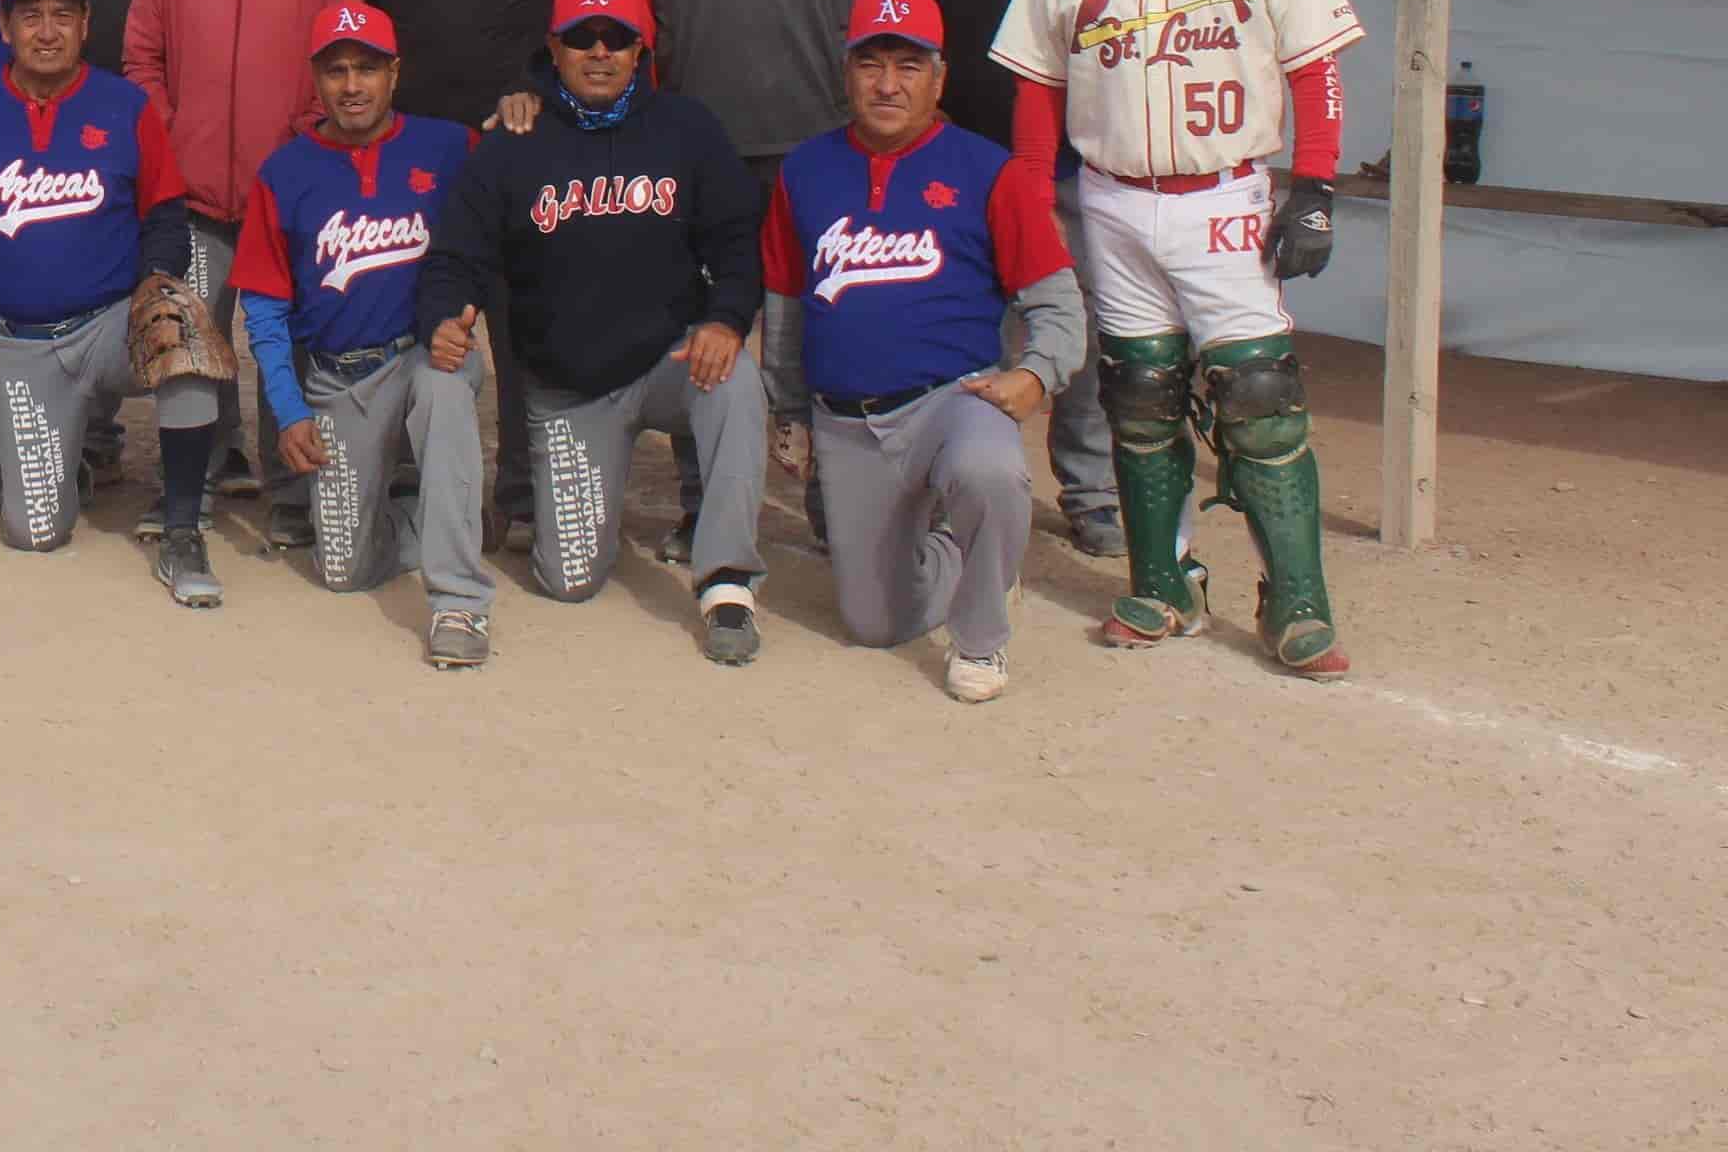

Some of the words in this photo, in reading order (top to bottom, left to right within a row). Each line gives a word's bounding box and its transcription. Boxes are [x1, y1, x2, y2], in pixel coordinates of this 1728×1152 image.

[333, 8, 366, 32] A's
[1099, 15, 1140, 68] St.
[1146, 12, 1240, 67] Louis
[1184, 80, 1245, 136] 50
[530, 175, 677, 233] GALLOS
[316, 209, 430, 293] Aztecas
[813, 215, 942, 305] Aztecas
[1208, 214, 1266, 254] KR
[33, 402, 60, 514] GUADALUPE
[51, 428, 65, 483] ORIENTE
[338, 439, 353, 559] GUADALUPE
[573, 439, 598, 559] GUADALUPE
[590, 464, 606, 525] ORIENTE
